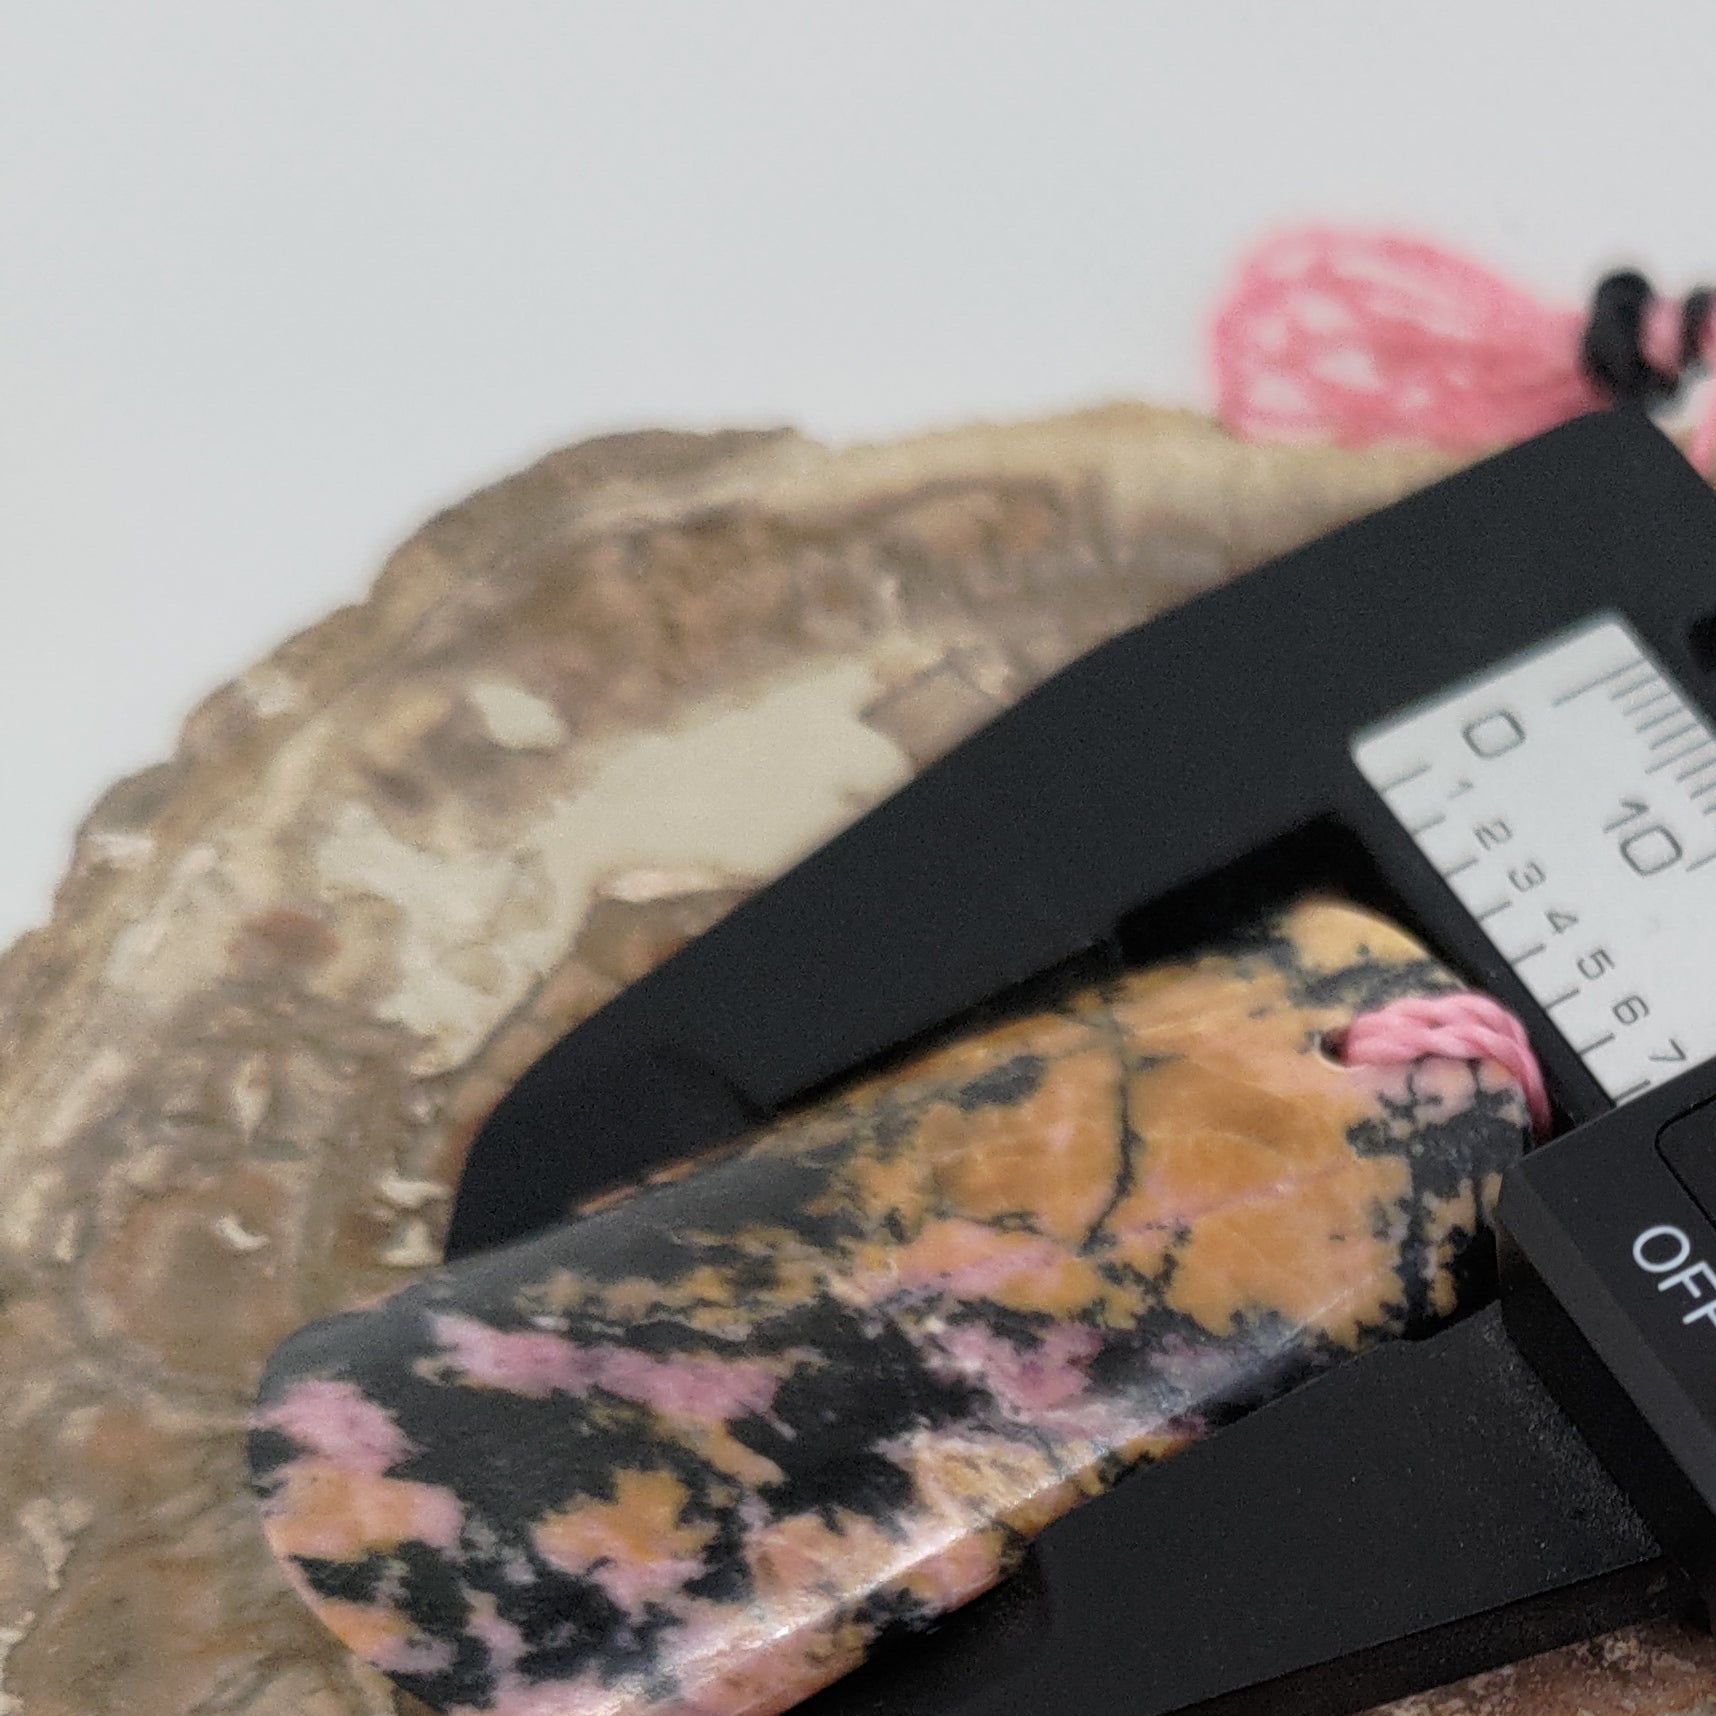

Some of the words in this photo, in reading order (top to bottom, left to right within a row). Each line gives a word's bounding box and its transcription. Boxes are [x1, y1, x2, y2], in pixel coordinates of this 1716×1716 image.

[1462, 710, 1525, 760] 0
[1604, 797, 1683, 877] 10
[1448, 778, 1474, 800] 1
[1474, 820, 1513, 850] 2
[1508, 862, 1547, 893] 3
[1545, 908, 1580, 935] 4
[1576, 950, 1615, 980] 5
[1612, 995, 1650, 1026] 6
[1650, 1038, 1687, 1067] 7
